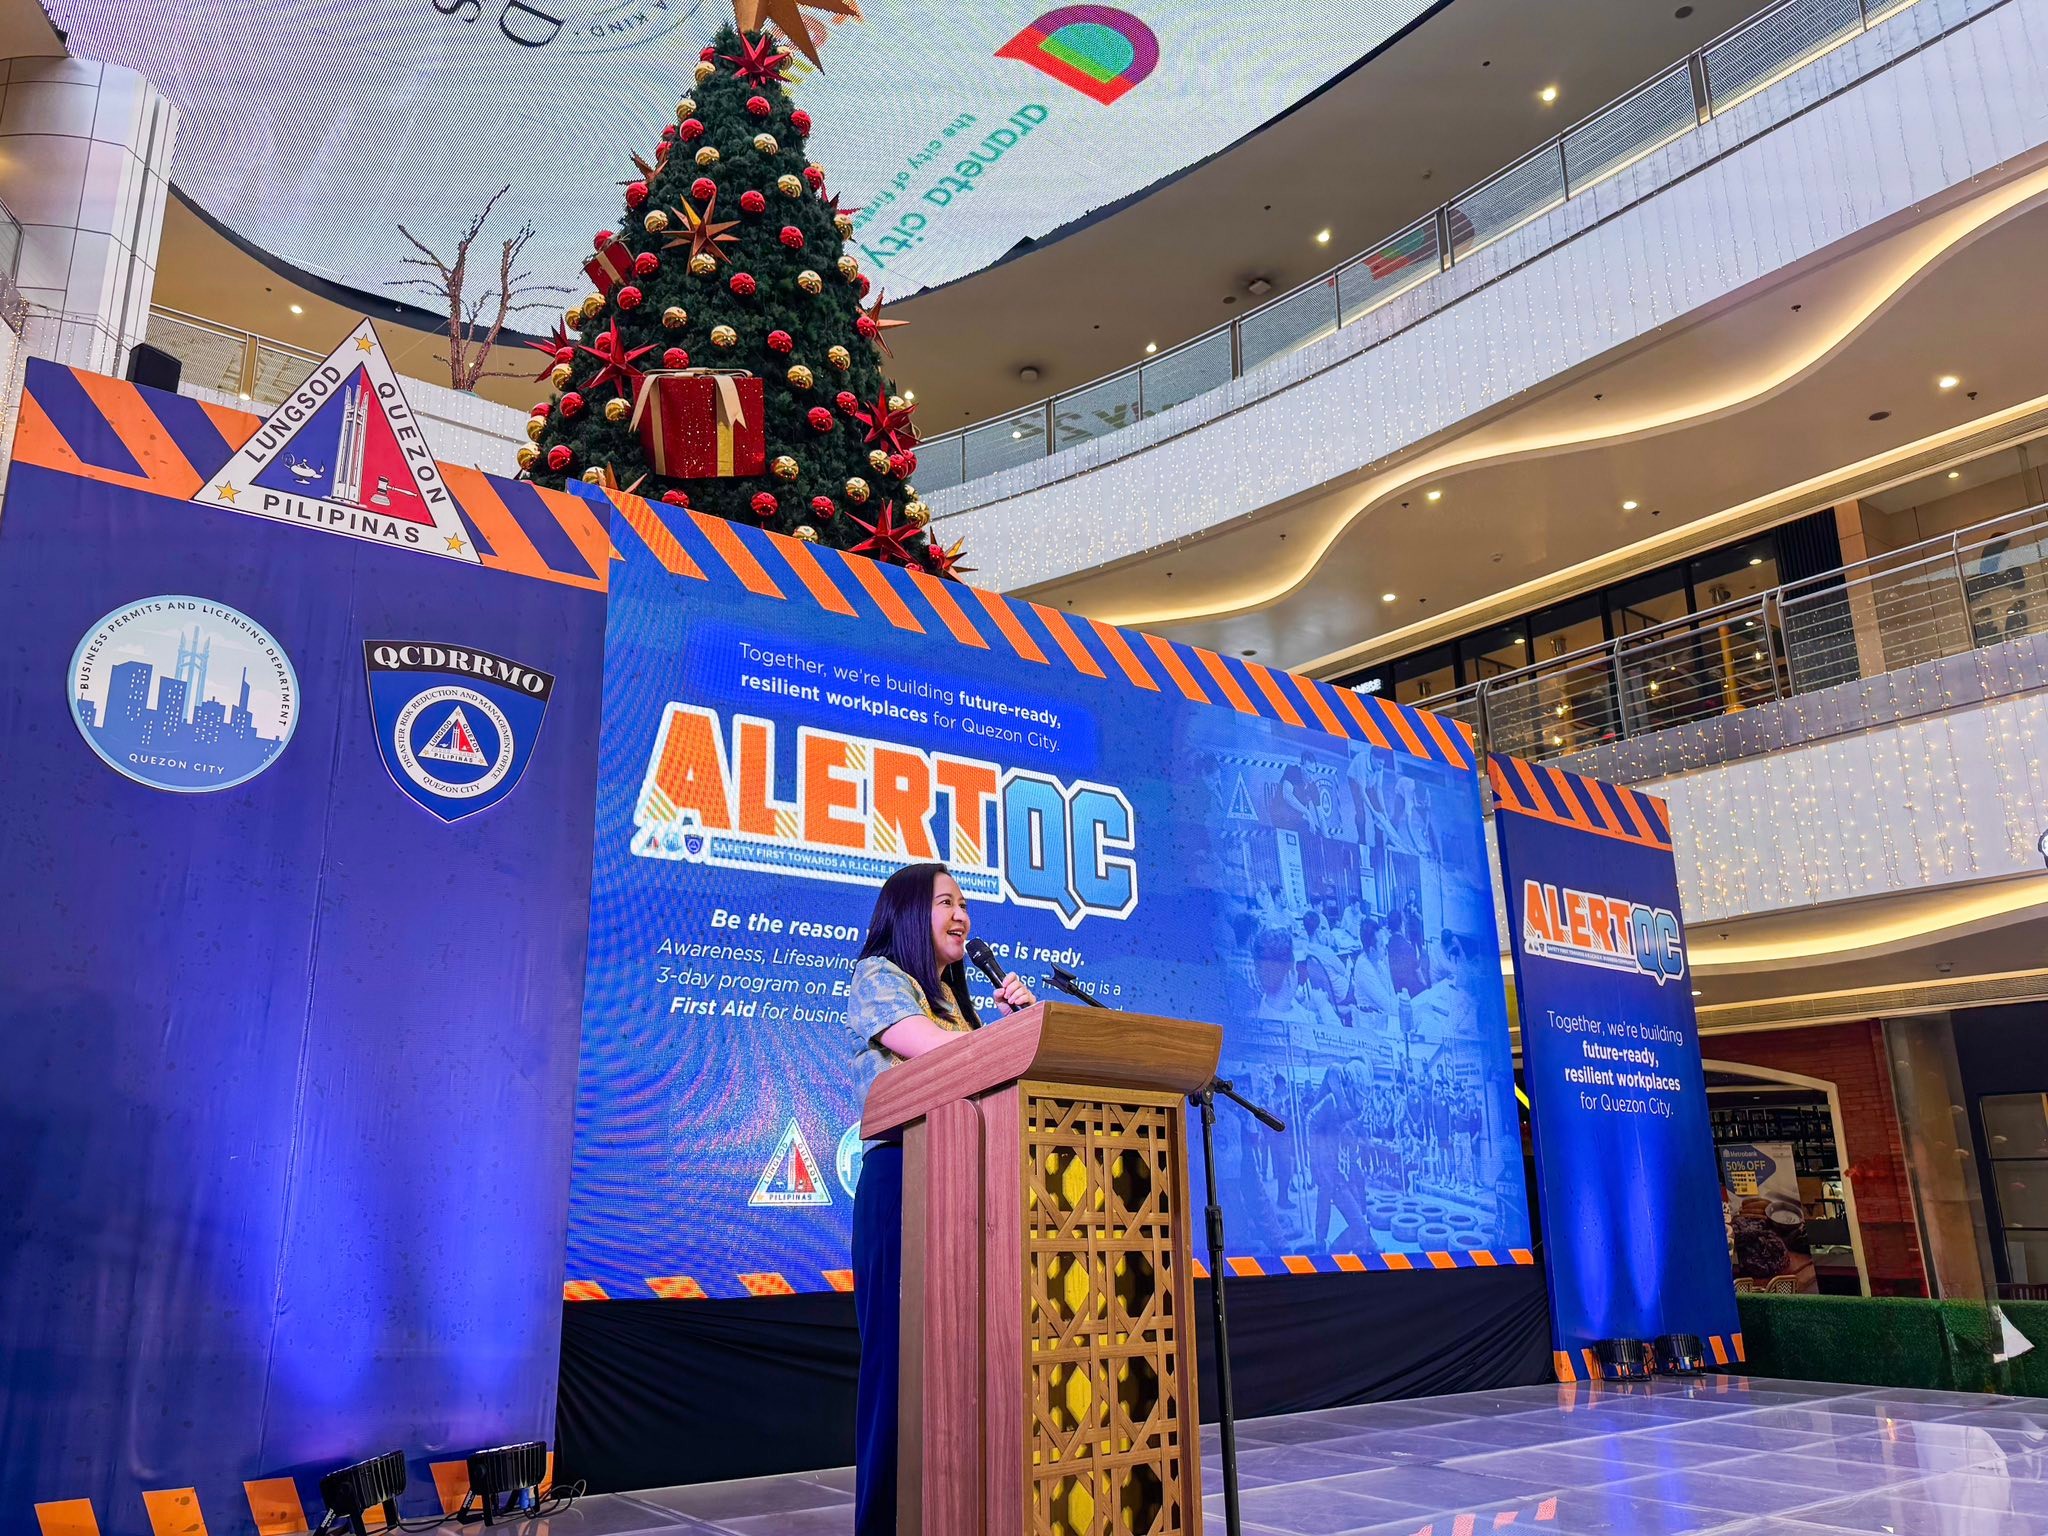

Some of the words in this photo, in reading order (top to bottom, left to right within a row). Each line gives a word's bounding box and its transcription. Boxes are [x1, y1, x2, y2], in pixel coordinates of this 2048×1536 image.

[942, 112, 978, 138] the
[907, 138, 943, 170] city
[922, 103, 1050, 209] araneta
[859, 211, 928, 269] city
[244, 365, 341, 463] LUNGSOD
[377, 381, 446, 504] QUEZON
[263, 493, 420, 543] PILIPINAS
[80, 633, 108, 690] BUSINESS
[108, 603, 162, 633] PERMITS
[168, 602, 196, 611] AND
[203, 605, 267, 646] LICENSING
[266, 648, 293, 727] DEPARTMENT
[373, 646, 545, 693] QCDRRMO
[411, 689, 458, 710] REDUCTION
[459, 691, 479, 702] AND
[739, 641, 828, 678] Together,
[833, 666, 881, 687] we're
[886, 674, 954, 706] building
[959, 690, 1062, 729] future-ready,
[400, 708, 414, 727] RISK
[478, 698, 511, 754] MANAGEMENT
[741, 672, 820, 702] resilient
[826, 689, 928, 725] workplaces
[933, 710, 956, 729] for
[961, 717, 1022, 744] Quezon
[1027, 731, 1061, 753] City.
[430, 720, 452, 747] LUNGSOD
[462, 723, 481, 753] QUEZON
[397, 728, 413, 769] DISASTER
[433, 752, 474, 763] PILIPINAS
[128, 753, 188, 769] QUEZON
[193, 762, 225, 775] CITY
[491, 755, 509, 780] OFFICE
[422, 776, 459, 794] QUEZON
[460, 782, 481, 794] CITY
[713, 841, 755, 854] SAFETY
[756, 845, 785, 859] FIRST
[788, 851, 838, 867] TOWARDS
[839, 859, 847, 868] A
[955, 874, 997, 889] MMUNITY
[711, 908, 741, 929] Be
[747, 912, 784, 934] the
[788, 918, 859, 942] reason
[656, 938, 766, 965] Awareness,
[1014, 940, 1029, 960] is
[1033, 945, 1085, 968] ready.
[656, 966, 714, 990] 3-day
[717, 973, 800, 993] program
[804, 981, 827, 995] on
[1099, 979, 1110, 994] is
[1113, 985, 1121, 996] a
[669, 996, 716, 1016] First
[721, 1000, 757, 1018] Aid
[761, 1002, 787, 1020] for
[792, 1005, 848, 1025] busine
[1546, 1010, 1605, 1036] Together,
[1607, 1020, 1638, 1038] we're
[1640, 1022, 1683, 1047] building
[1582, 1040, 1659, 1068] future-ready,
[1564, 1066, 1614, 1087] resilient
[1616, 1071, 1681, 1092] workplaces
[1580, 1091, 1597, 1110] for
[1600, 1095, 1647, 1115] Quezon
[1649, 1098, 1674, 1119] City.
[1726, 1160, 1745, 1171] 50%
[1746, 1160, 1766, 1170] OFF
